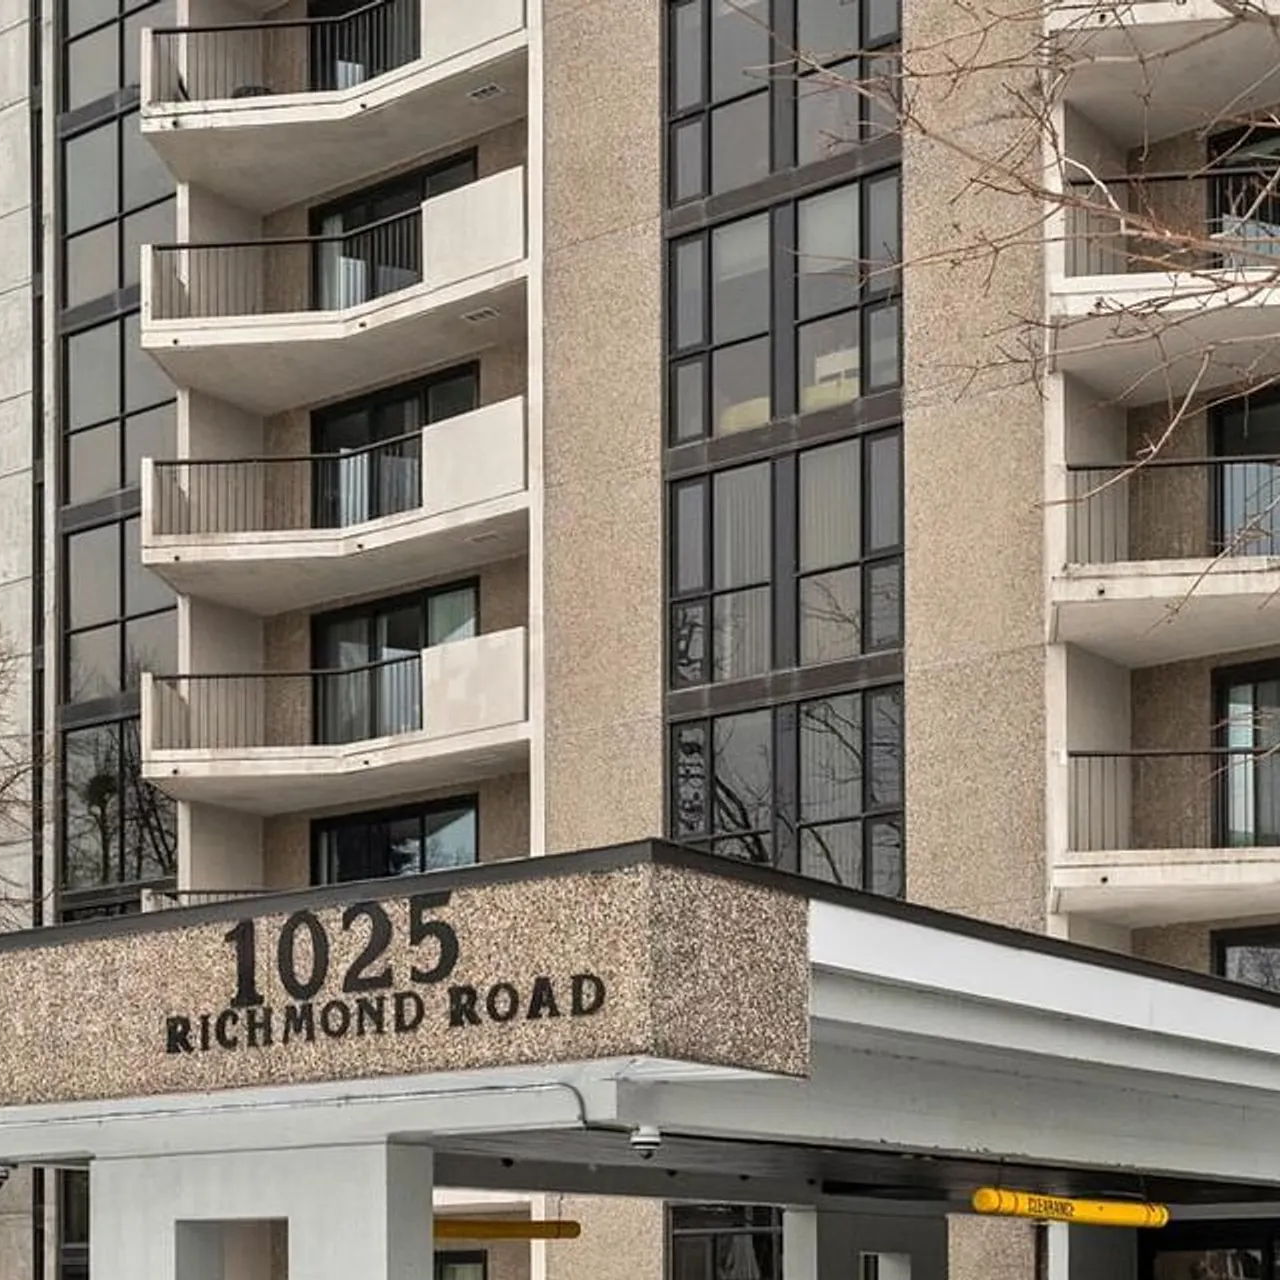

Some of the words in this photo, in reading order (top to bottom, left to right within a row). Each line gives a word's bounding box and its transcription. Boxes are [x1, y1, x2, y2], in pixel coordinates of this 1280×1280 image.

[225, 891, 459, 1006] 1025
[166, 991, 425, 1054] RICHMOND
[448, 973, 606, 1027] ROAD
